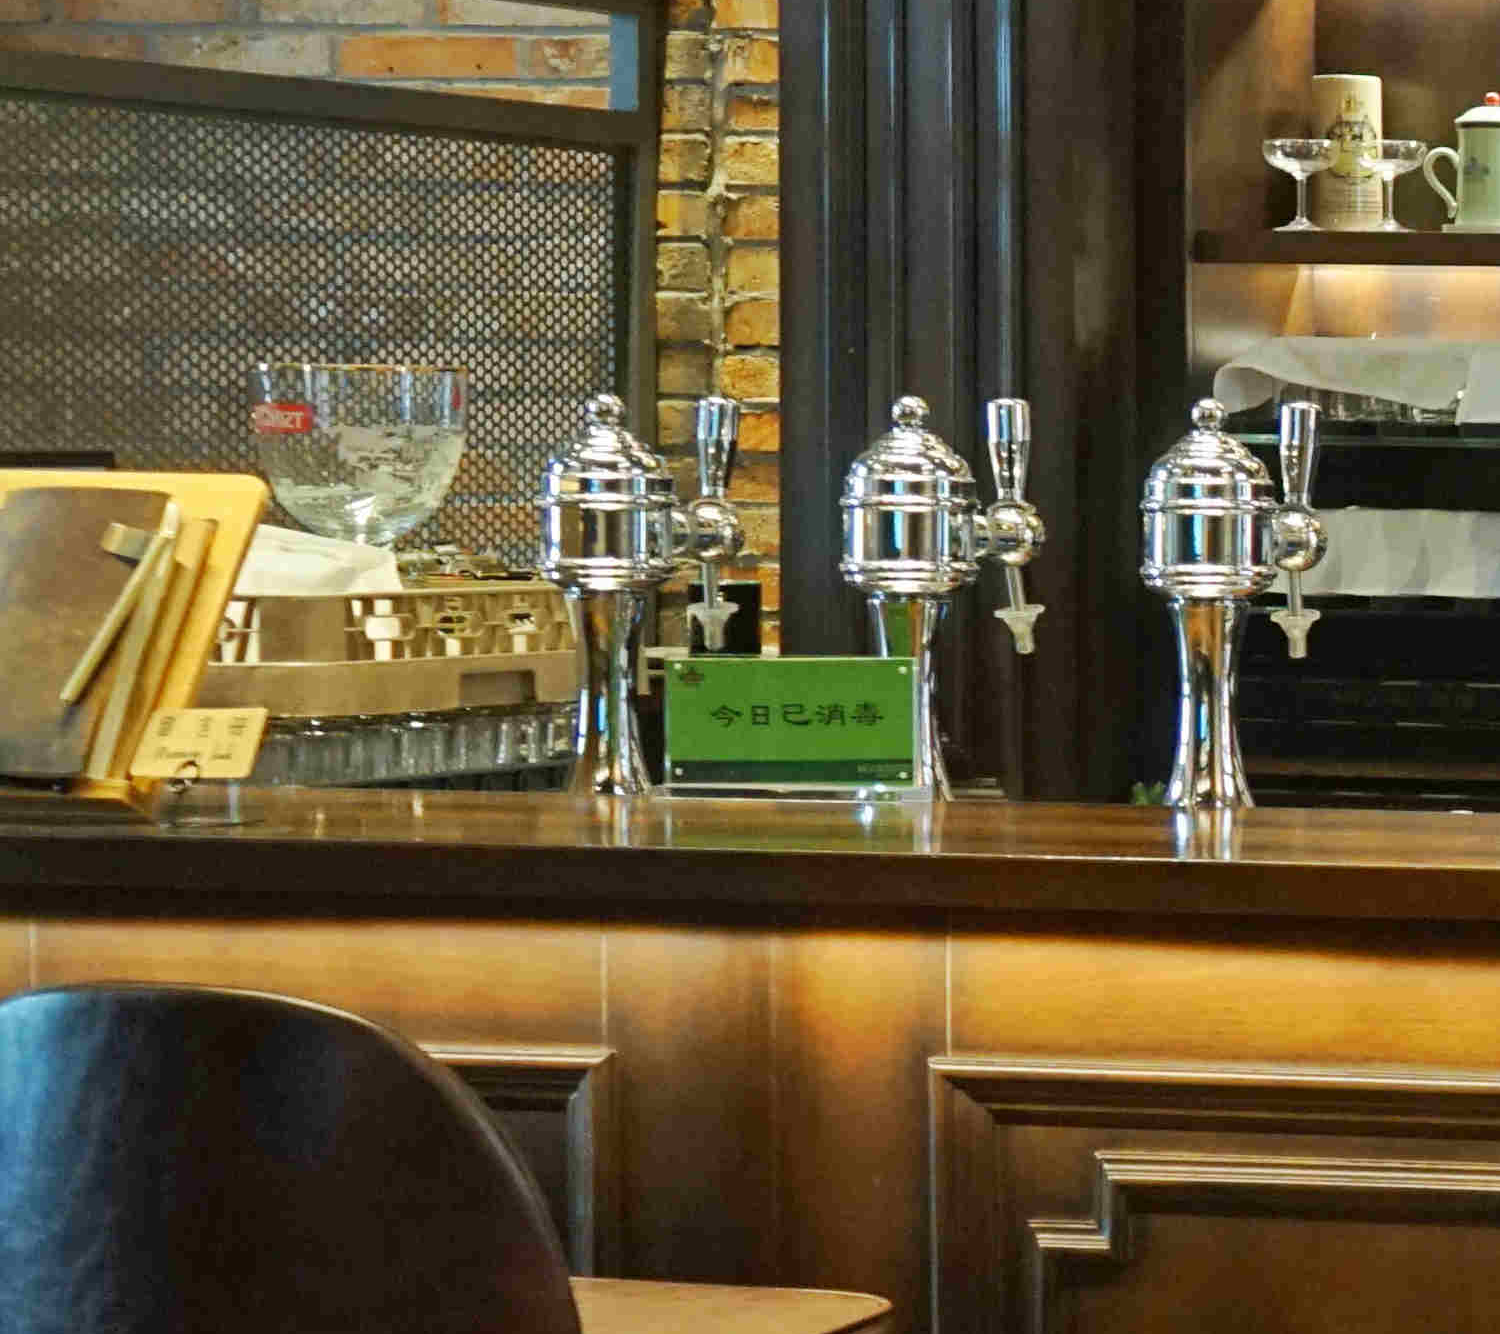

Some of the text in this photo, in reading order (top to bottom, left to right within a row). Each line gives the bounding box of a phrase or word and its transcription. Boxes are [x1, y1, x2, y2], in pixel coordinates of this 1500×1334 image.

[710, 701, 884, 728] 今日已消毒
